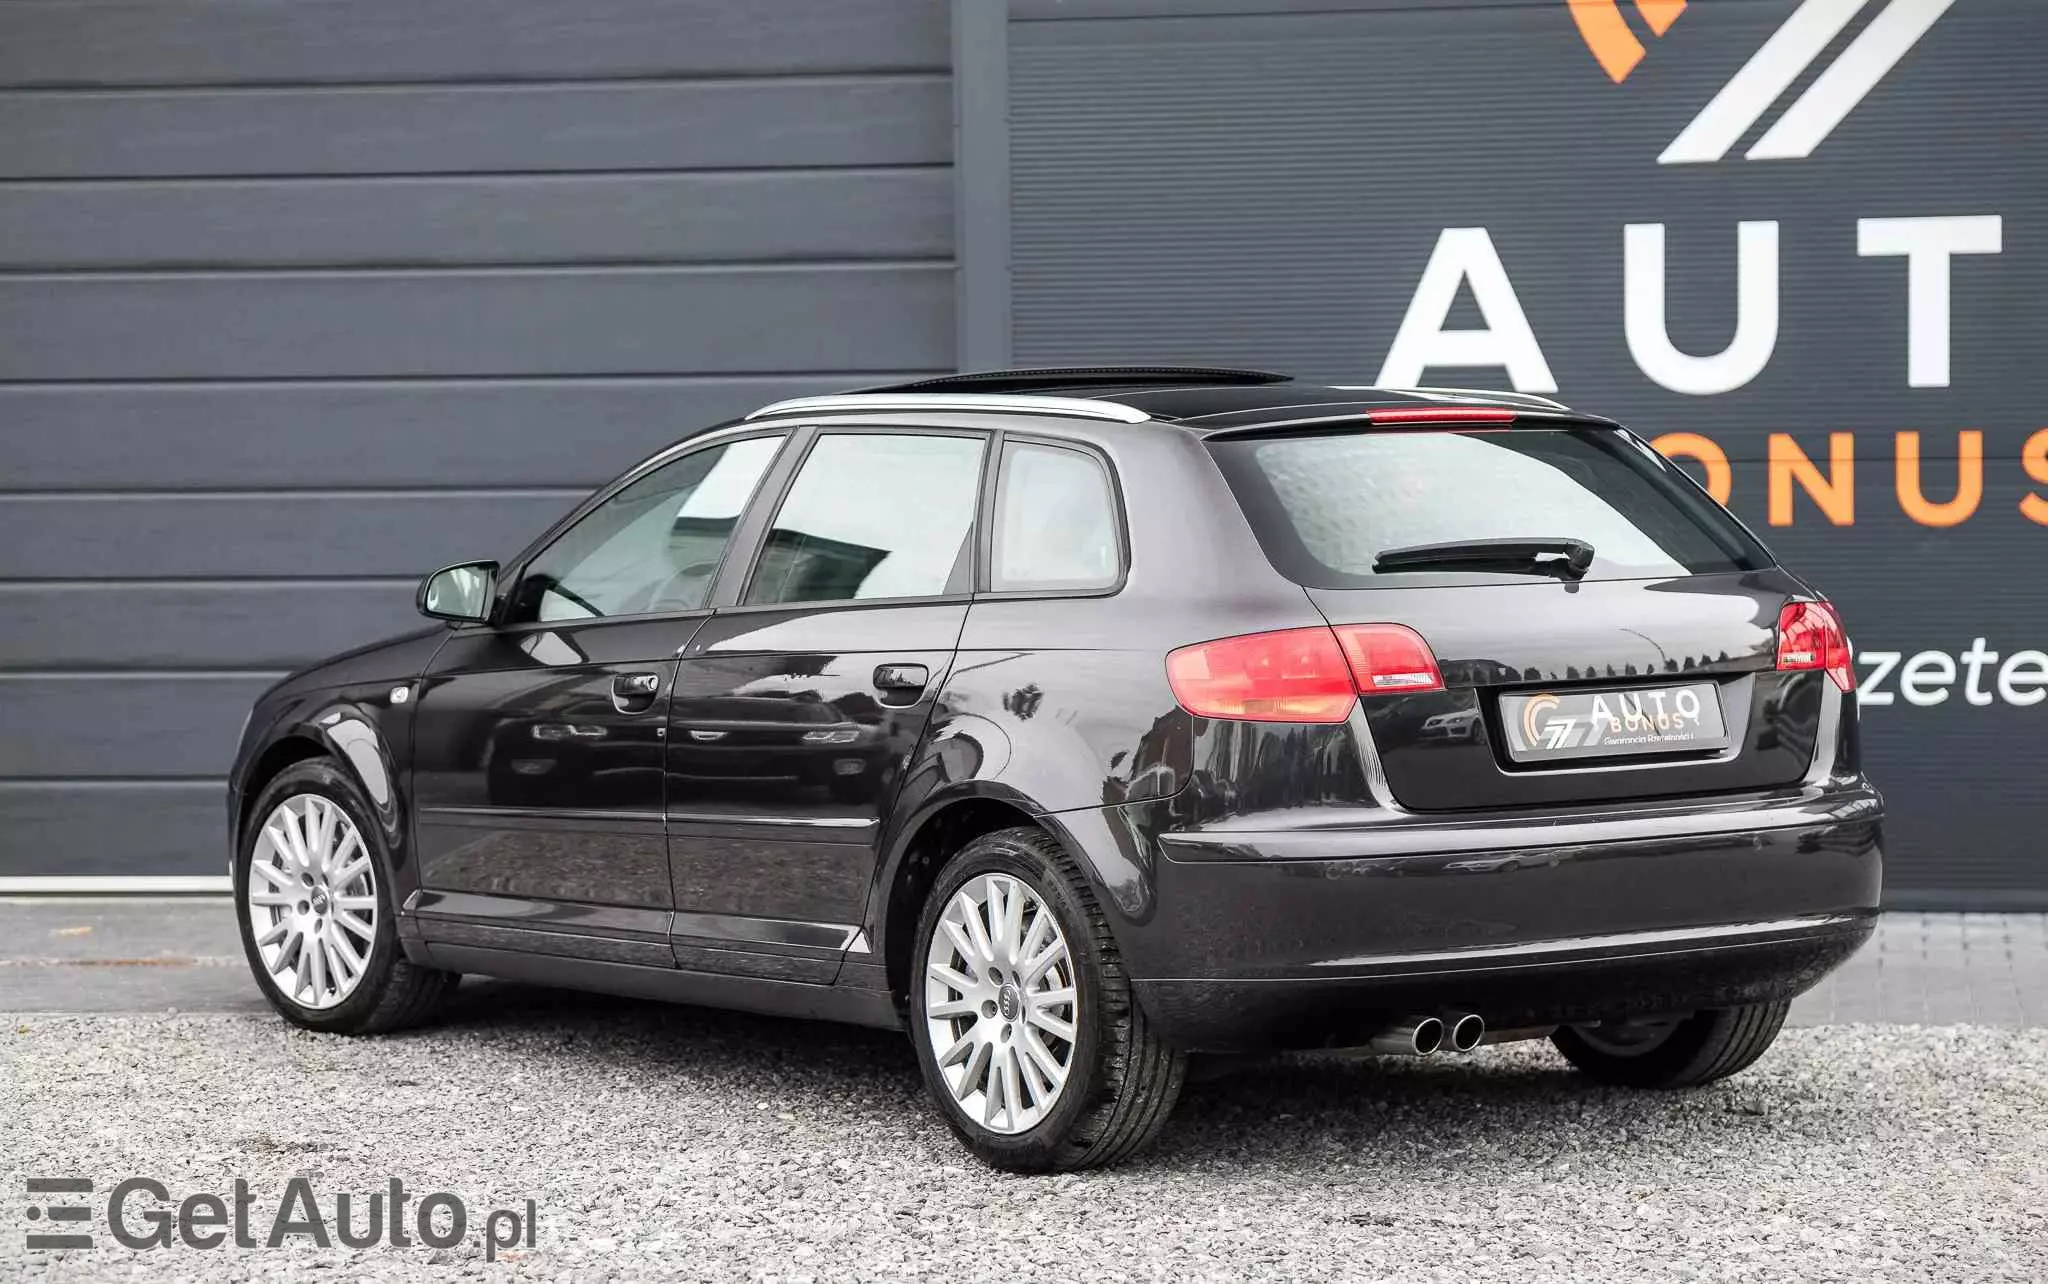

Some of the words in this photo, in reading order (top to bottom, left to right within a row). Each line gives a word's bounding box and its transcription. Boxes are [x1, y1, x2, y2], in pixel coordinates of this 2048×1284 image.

[1847, 637, 2048, 706] zete
[1591, 689, 1700, 722] AUTO
[1609, 712, 1684, 733] BONUS
